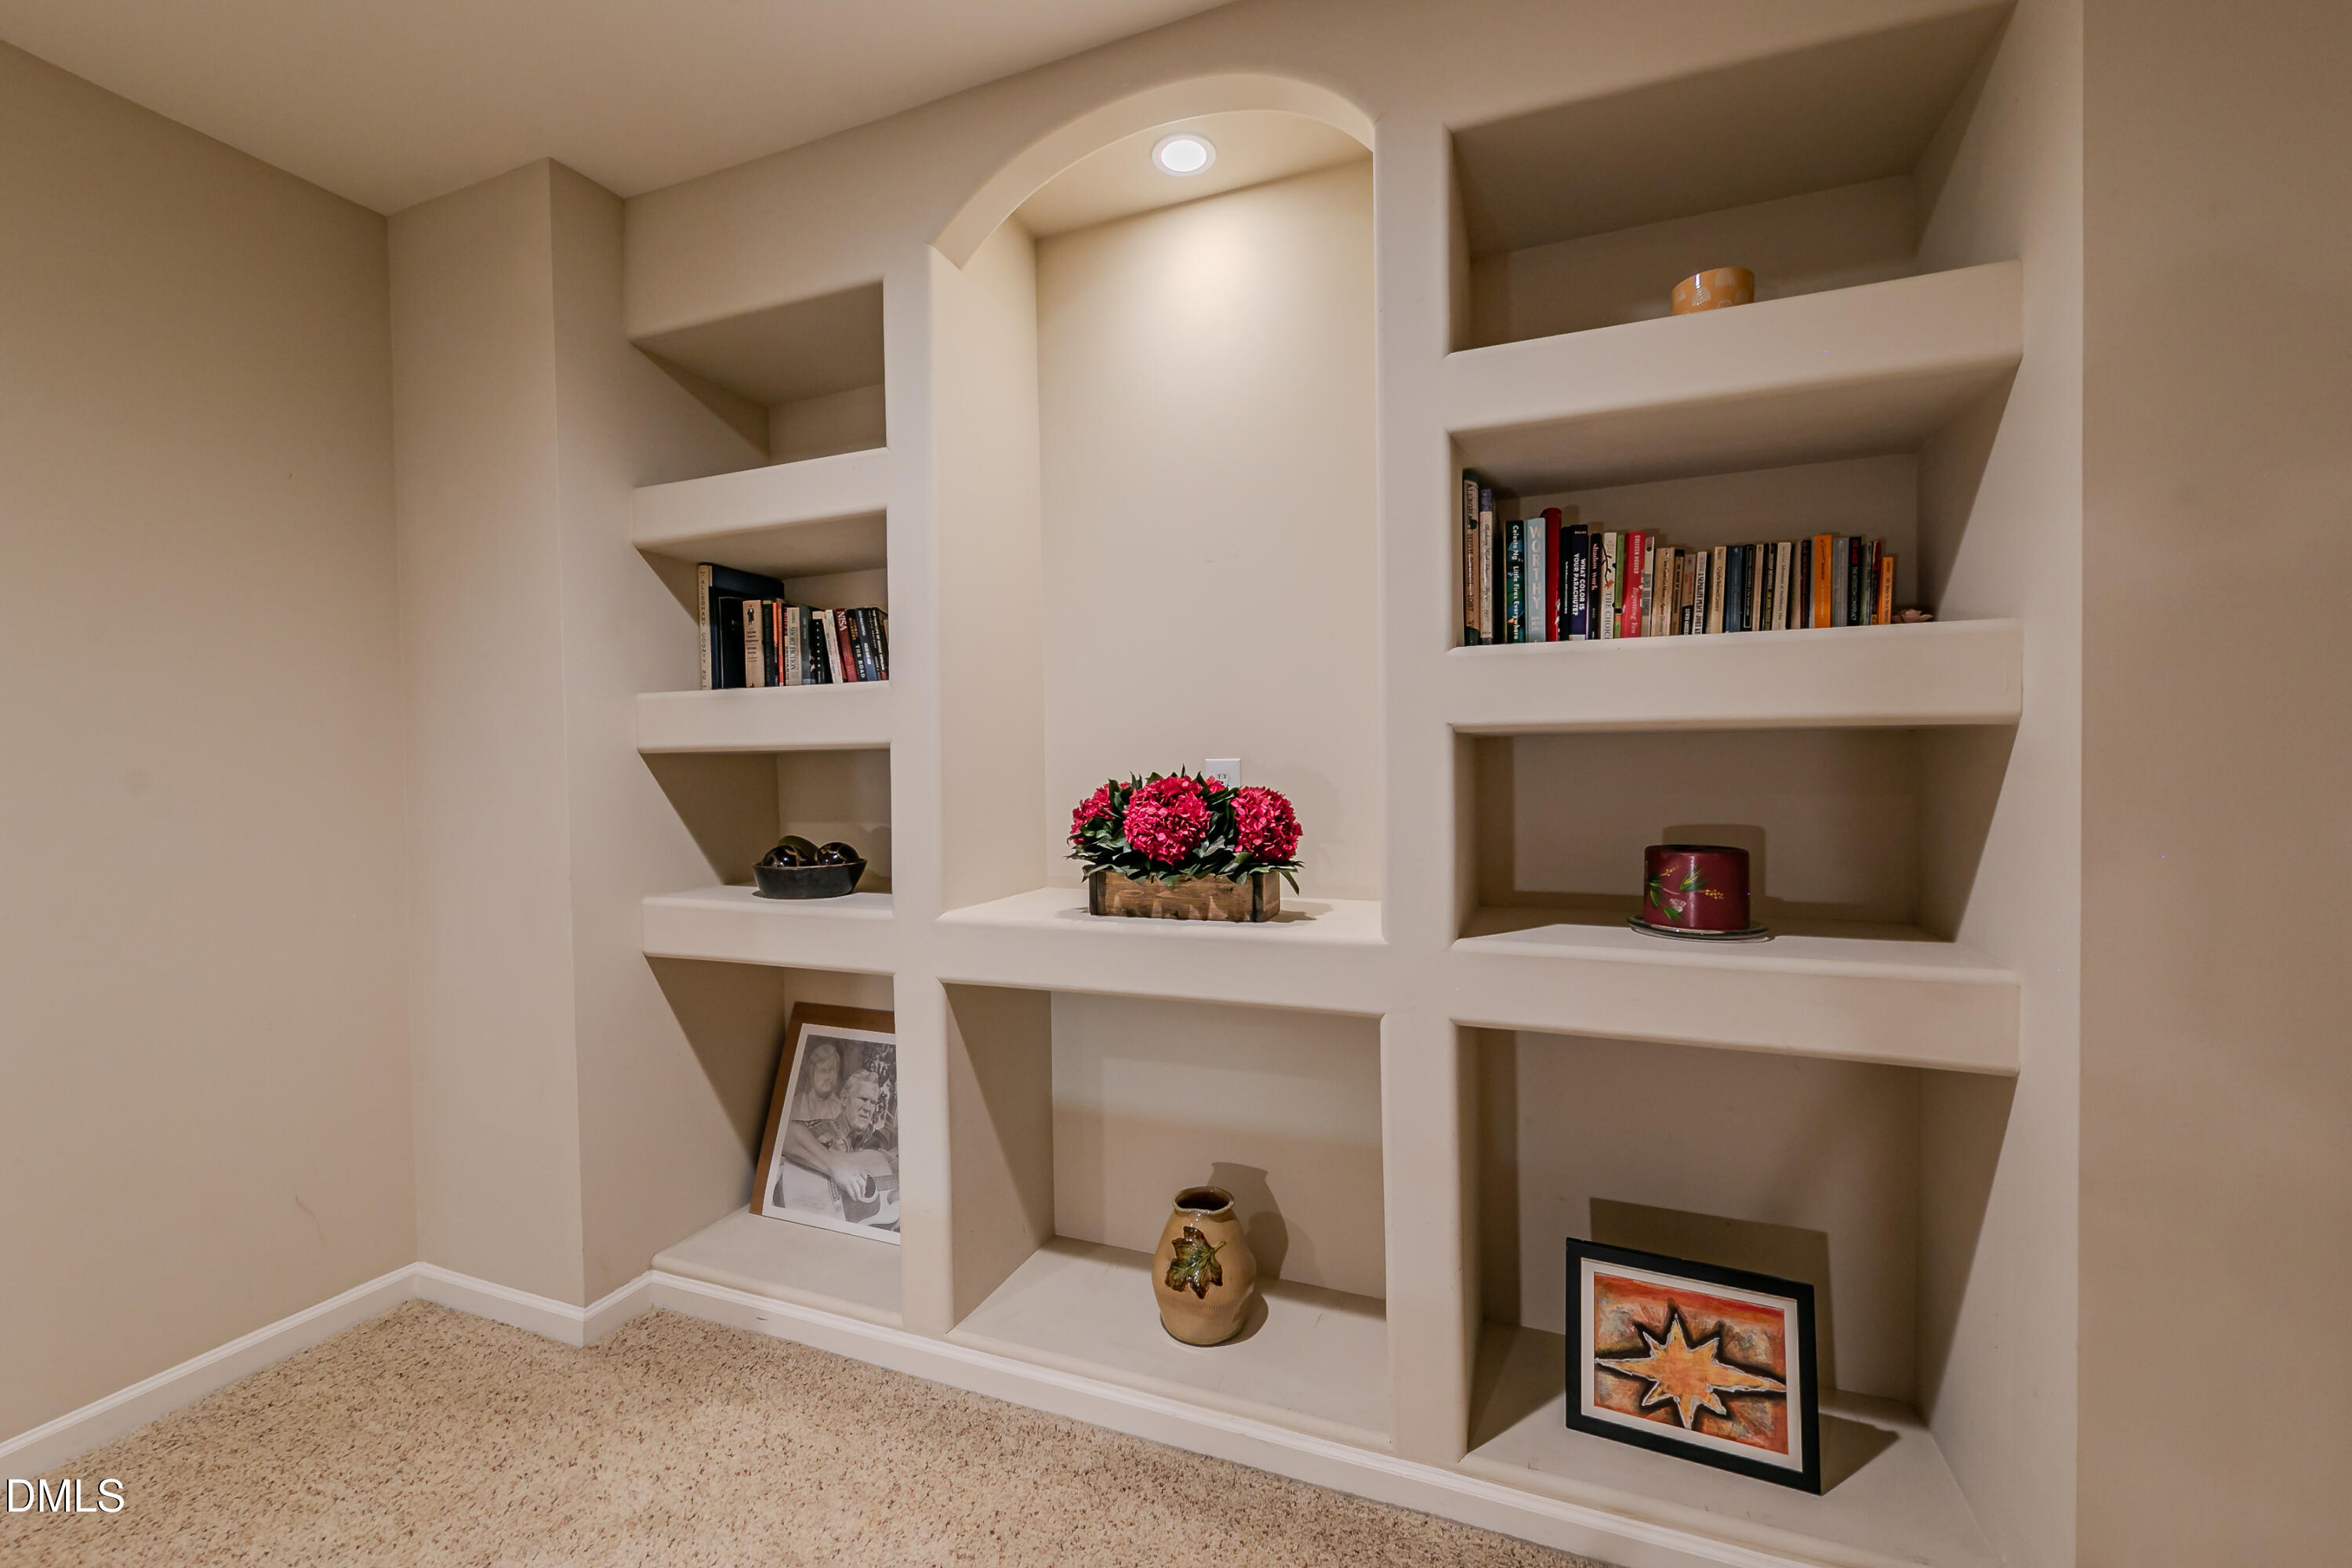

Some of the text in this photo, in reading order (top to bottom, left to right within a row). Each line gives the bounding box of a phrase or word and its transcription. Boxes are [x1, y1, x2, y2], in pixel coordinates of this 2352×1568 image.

[1512, 550, 1519, 561] Ng
[1529, 525, 1543, 610] WORTHY
[1630, 587, 1639, 621] Regretting
[837, 611, 848, 631] NISA
